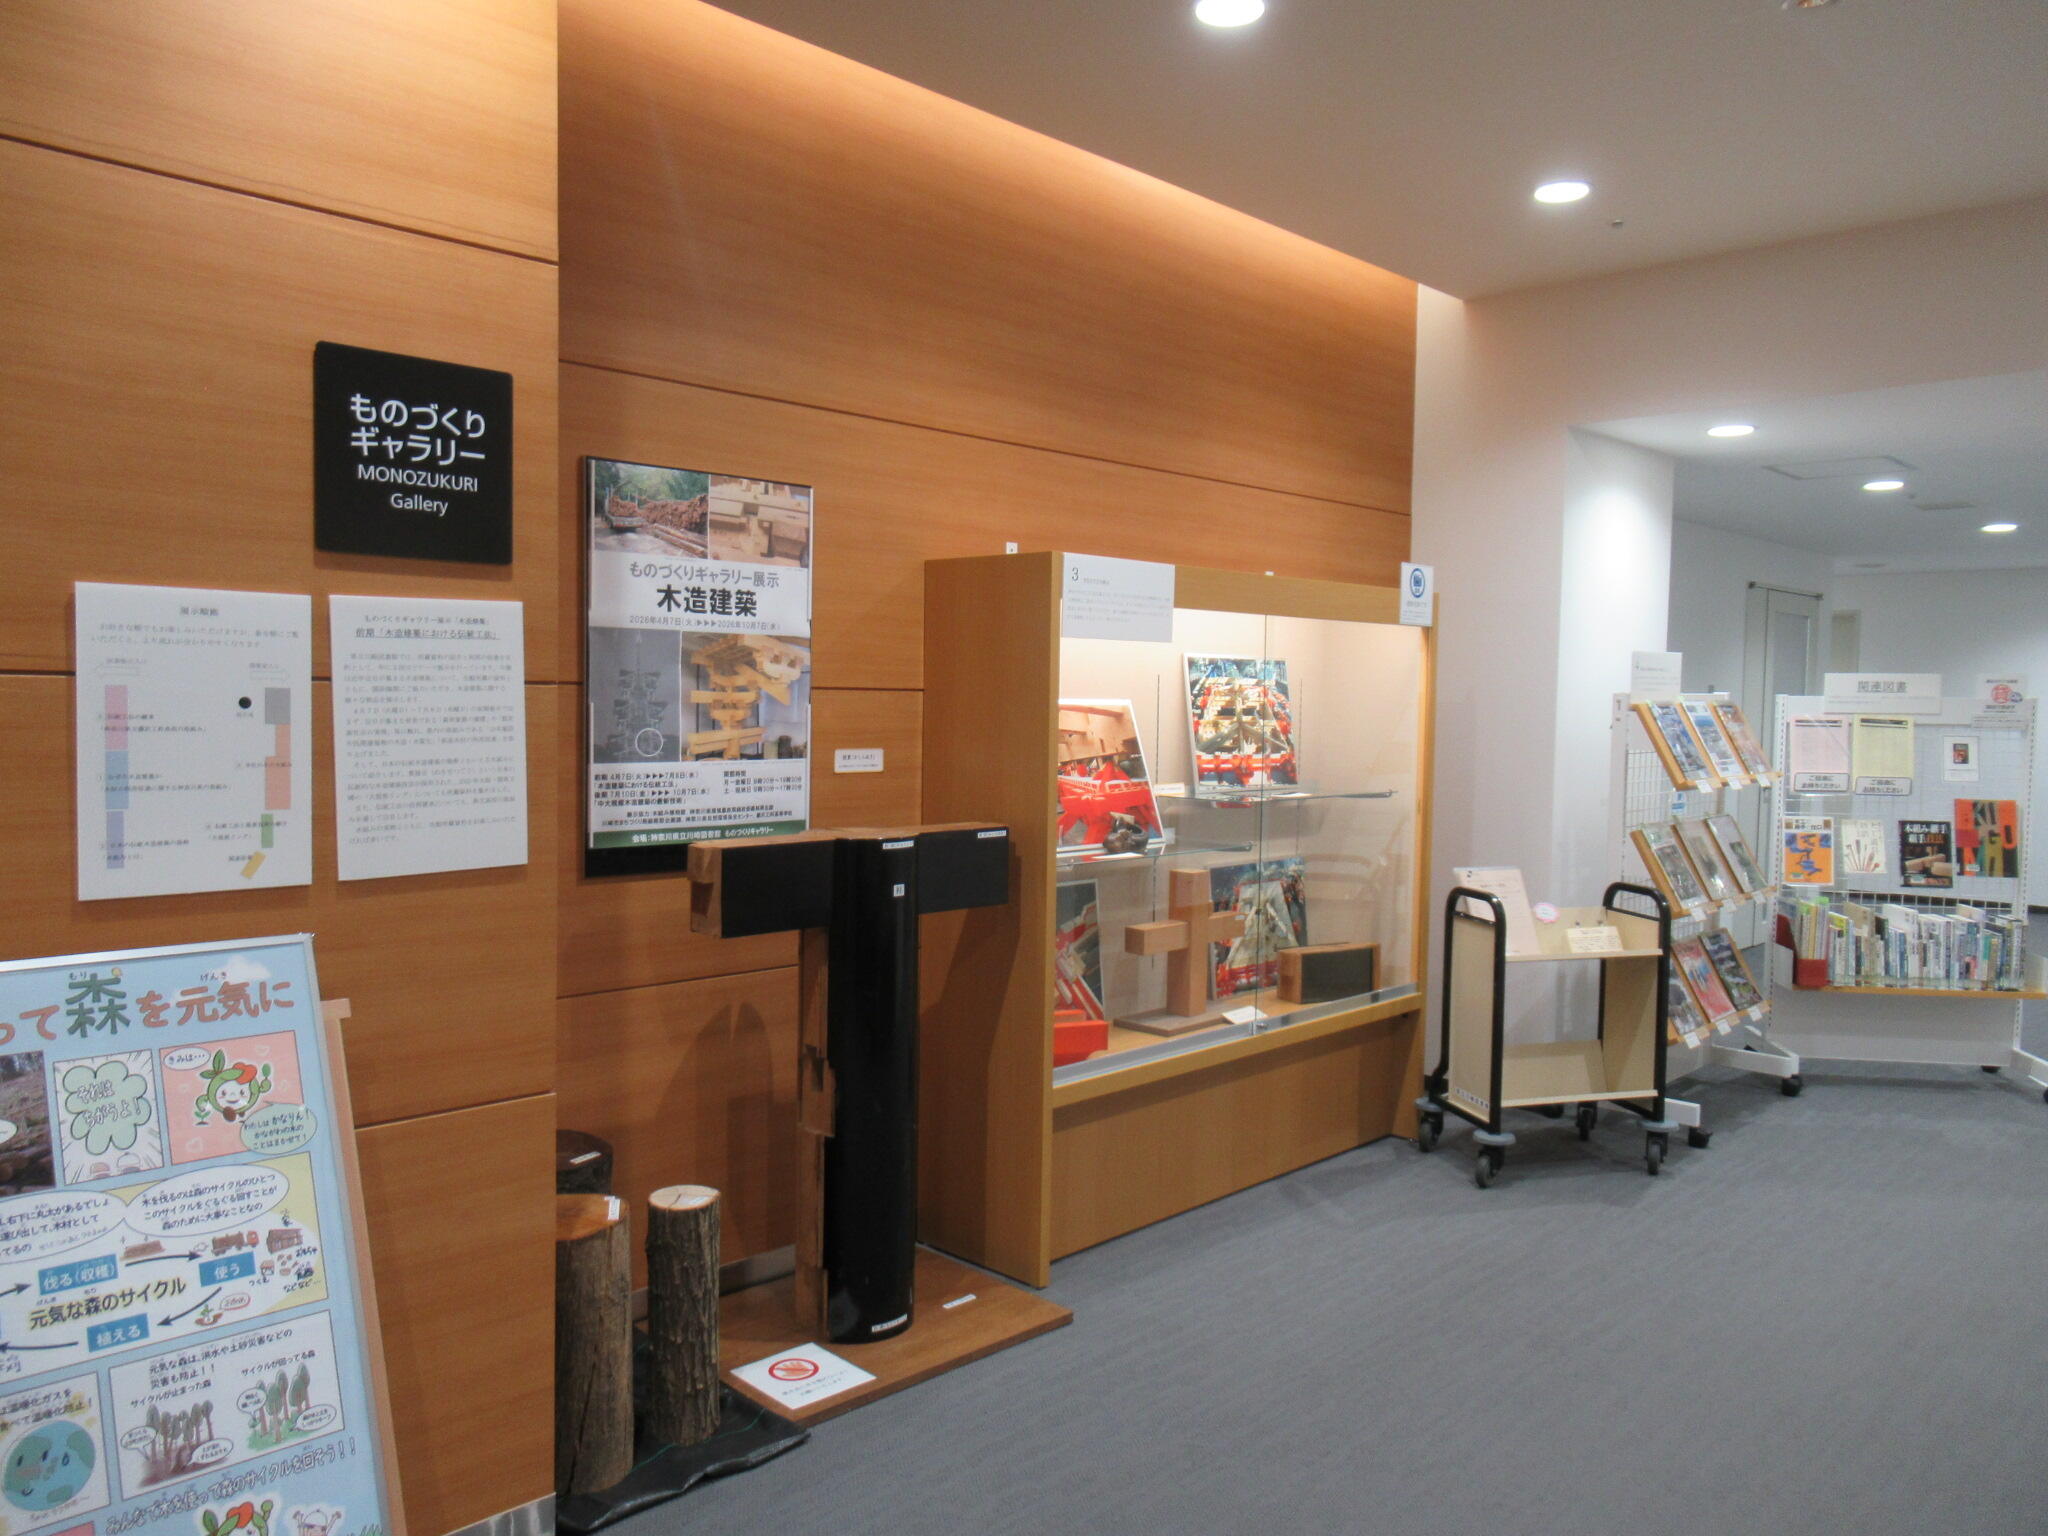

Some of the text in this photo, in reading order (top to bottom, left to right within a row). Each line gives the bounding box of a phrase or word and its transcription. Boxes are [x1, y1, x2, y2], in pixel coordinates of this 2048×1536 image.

[350, 393, 486, 438] ものづくり
[350, 426, 486, 466] ギャラリー
[357, 464, 478, 492] MONOZUKURI
[390, 493, 449, 517] Gallery
[629, 561, 780, 588] ものづくりギャラリー展示
[1071, 567, 1079, 582] 3
[656, 584, 757, 617] 木造建築
[214, 1265, 240, 1280] 使う
[29, 1278, 187, 1330] 元気な森のサイクル
[96, 1325, 141, 1345] 植える
